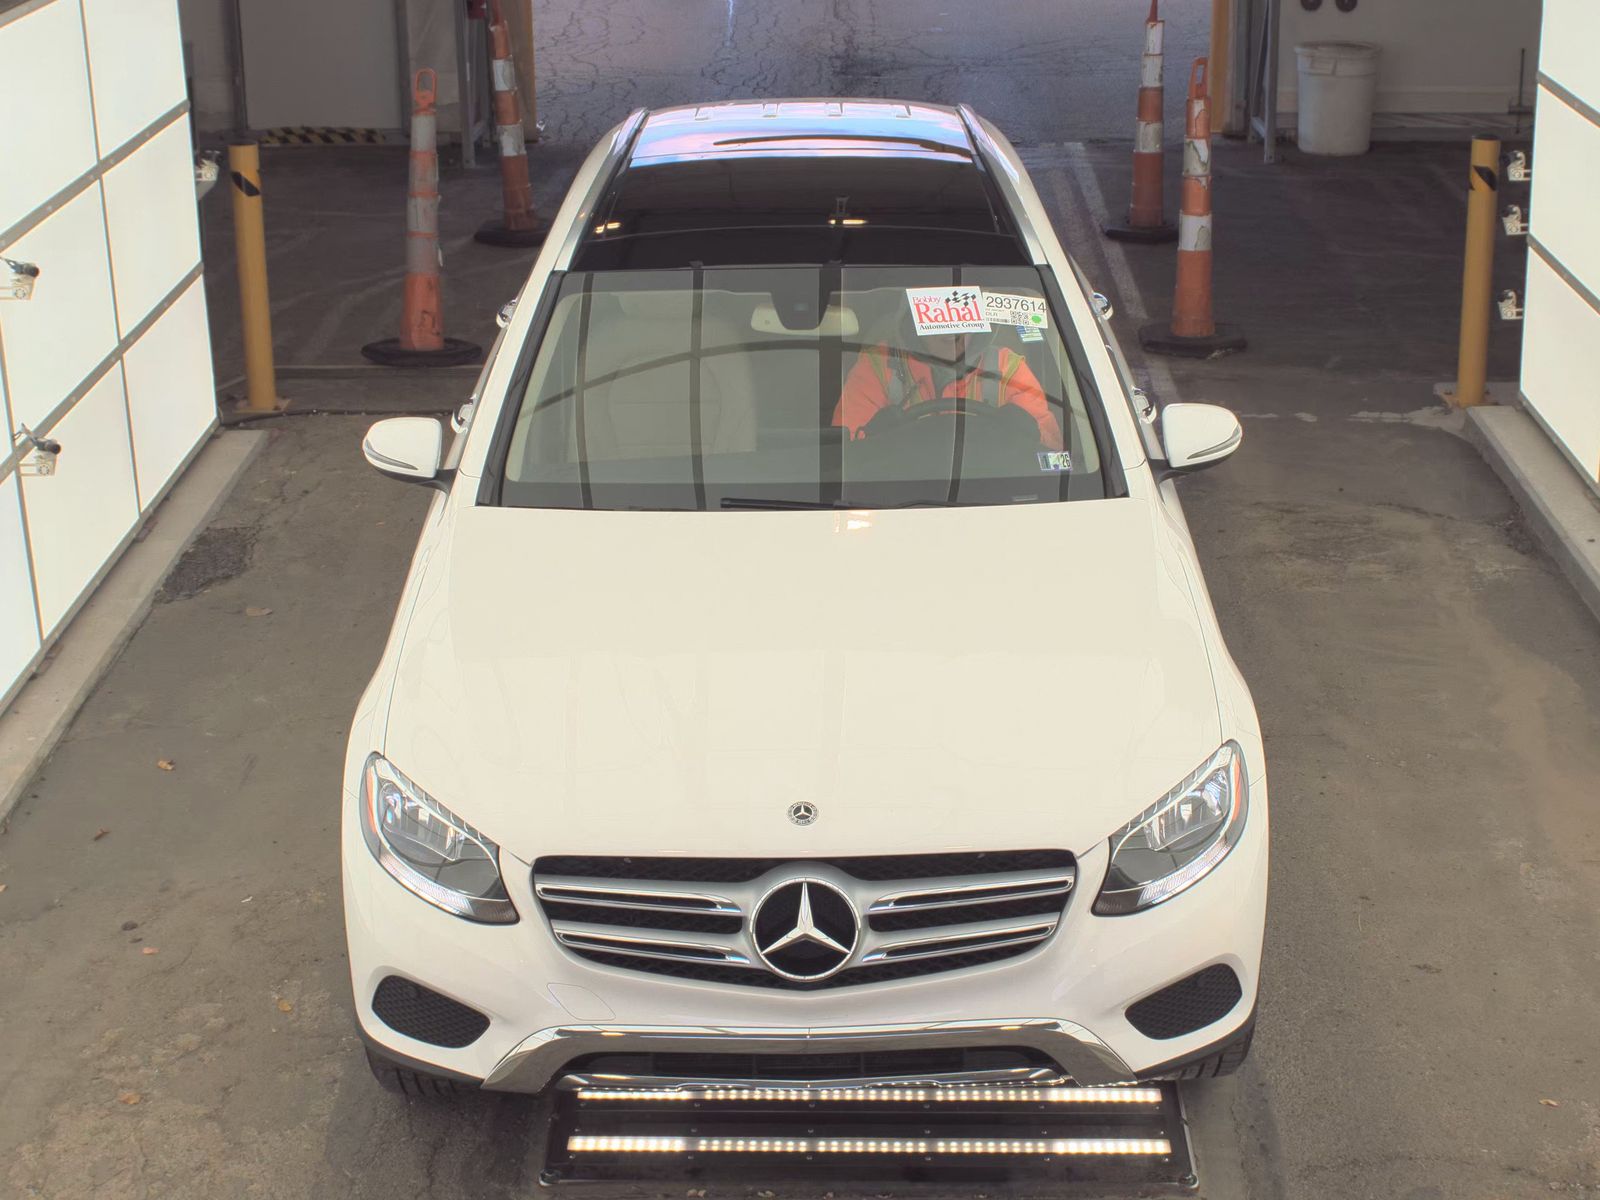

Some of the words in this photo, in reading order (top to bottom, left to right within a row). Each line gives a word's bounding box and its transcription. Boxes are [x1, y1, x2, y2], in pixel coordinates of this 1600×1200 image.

[913, 296, 941, 304] Bobby
[986, 296, 1047, 312] 2937614
[914, 299, 985, 324] Rahal
[919, 322, 960, 330] Automotive
[962, 321, 985, 329] Group
